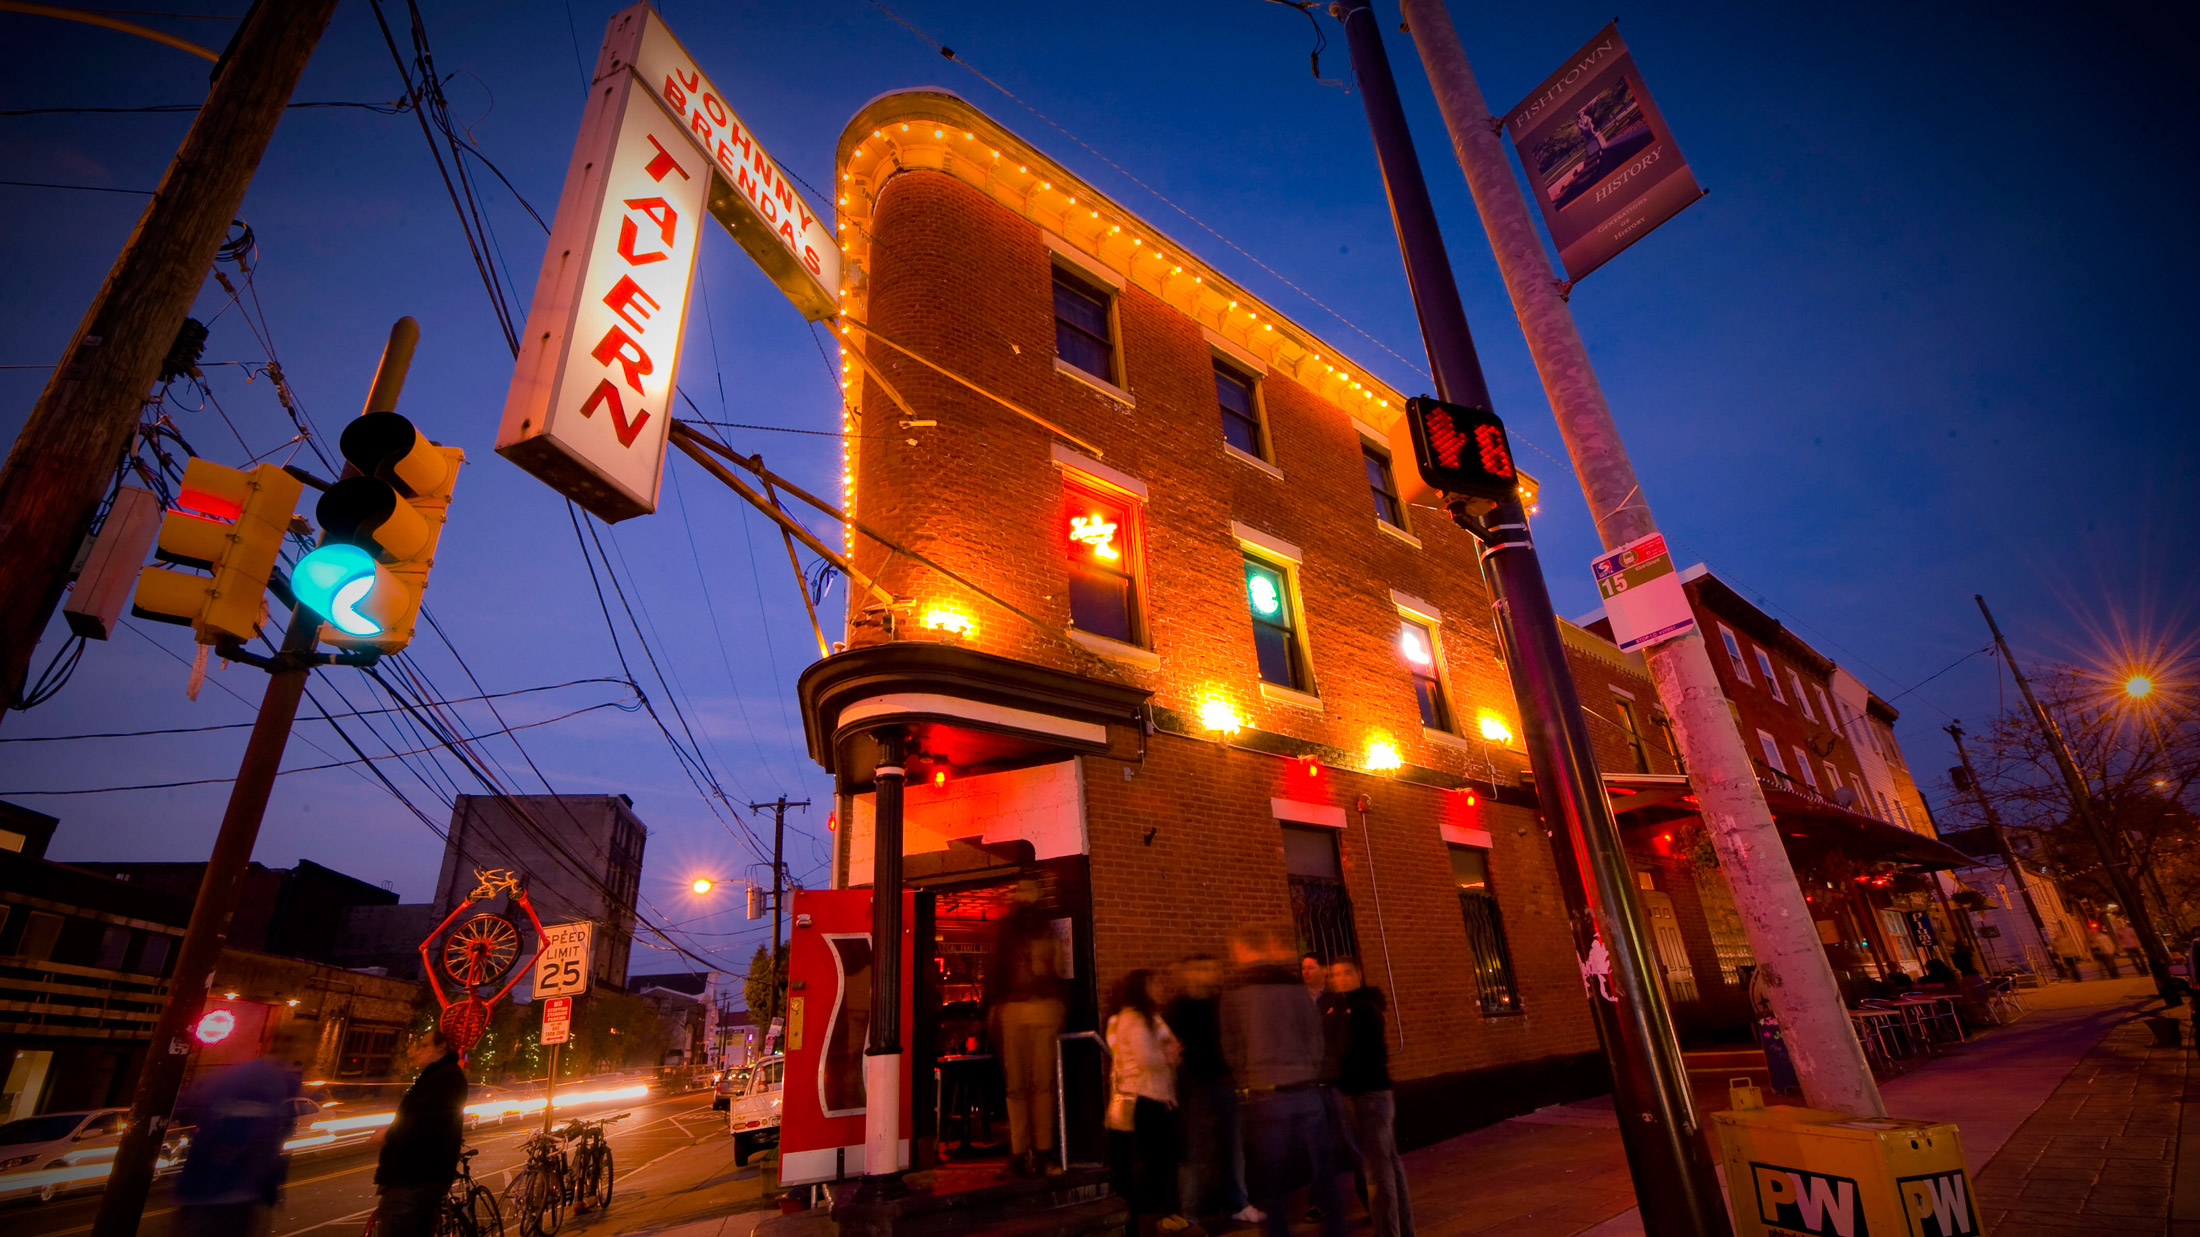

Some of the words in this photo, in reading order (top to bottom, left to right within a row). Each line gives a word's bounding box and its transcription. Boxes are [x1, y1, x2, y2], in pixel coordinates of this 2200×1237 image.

[1514, 39, 1614, 128] FISHTOWN
[663, 73, 821, 275] BRENDA'S
[675, 67, 813, 233] JOHNNY
[1595, 146, 1662, 204] HISTORY
[579, 133, 690, 449] TAVERN
[1602, 573, 1628, 596] 15
[540, 960, 580, 990] 25
[546, 946, 580, 960] LIMIT
[1755, 1166, 1854, 1237] PW
[1900, 1174, 1971, 1237] PW
